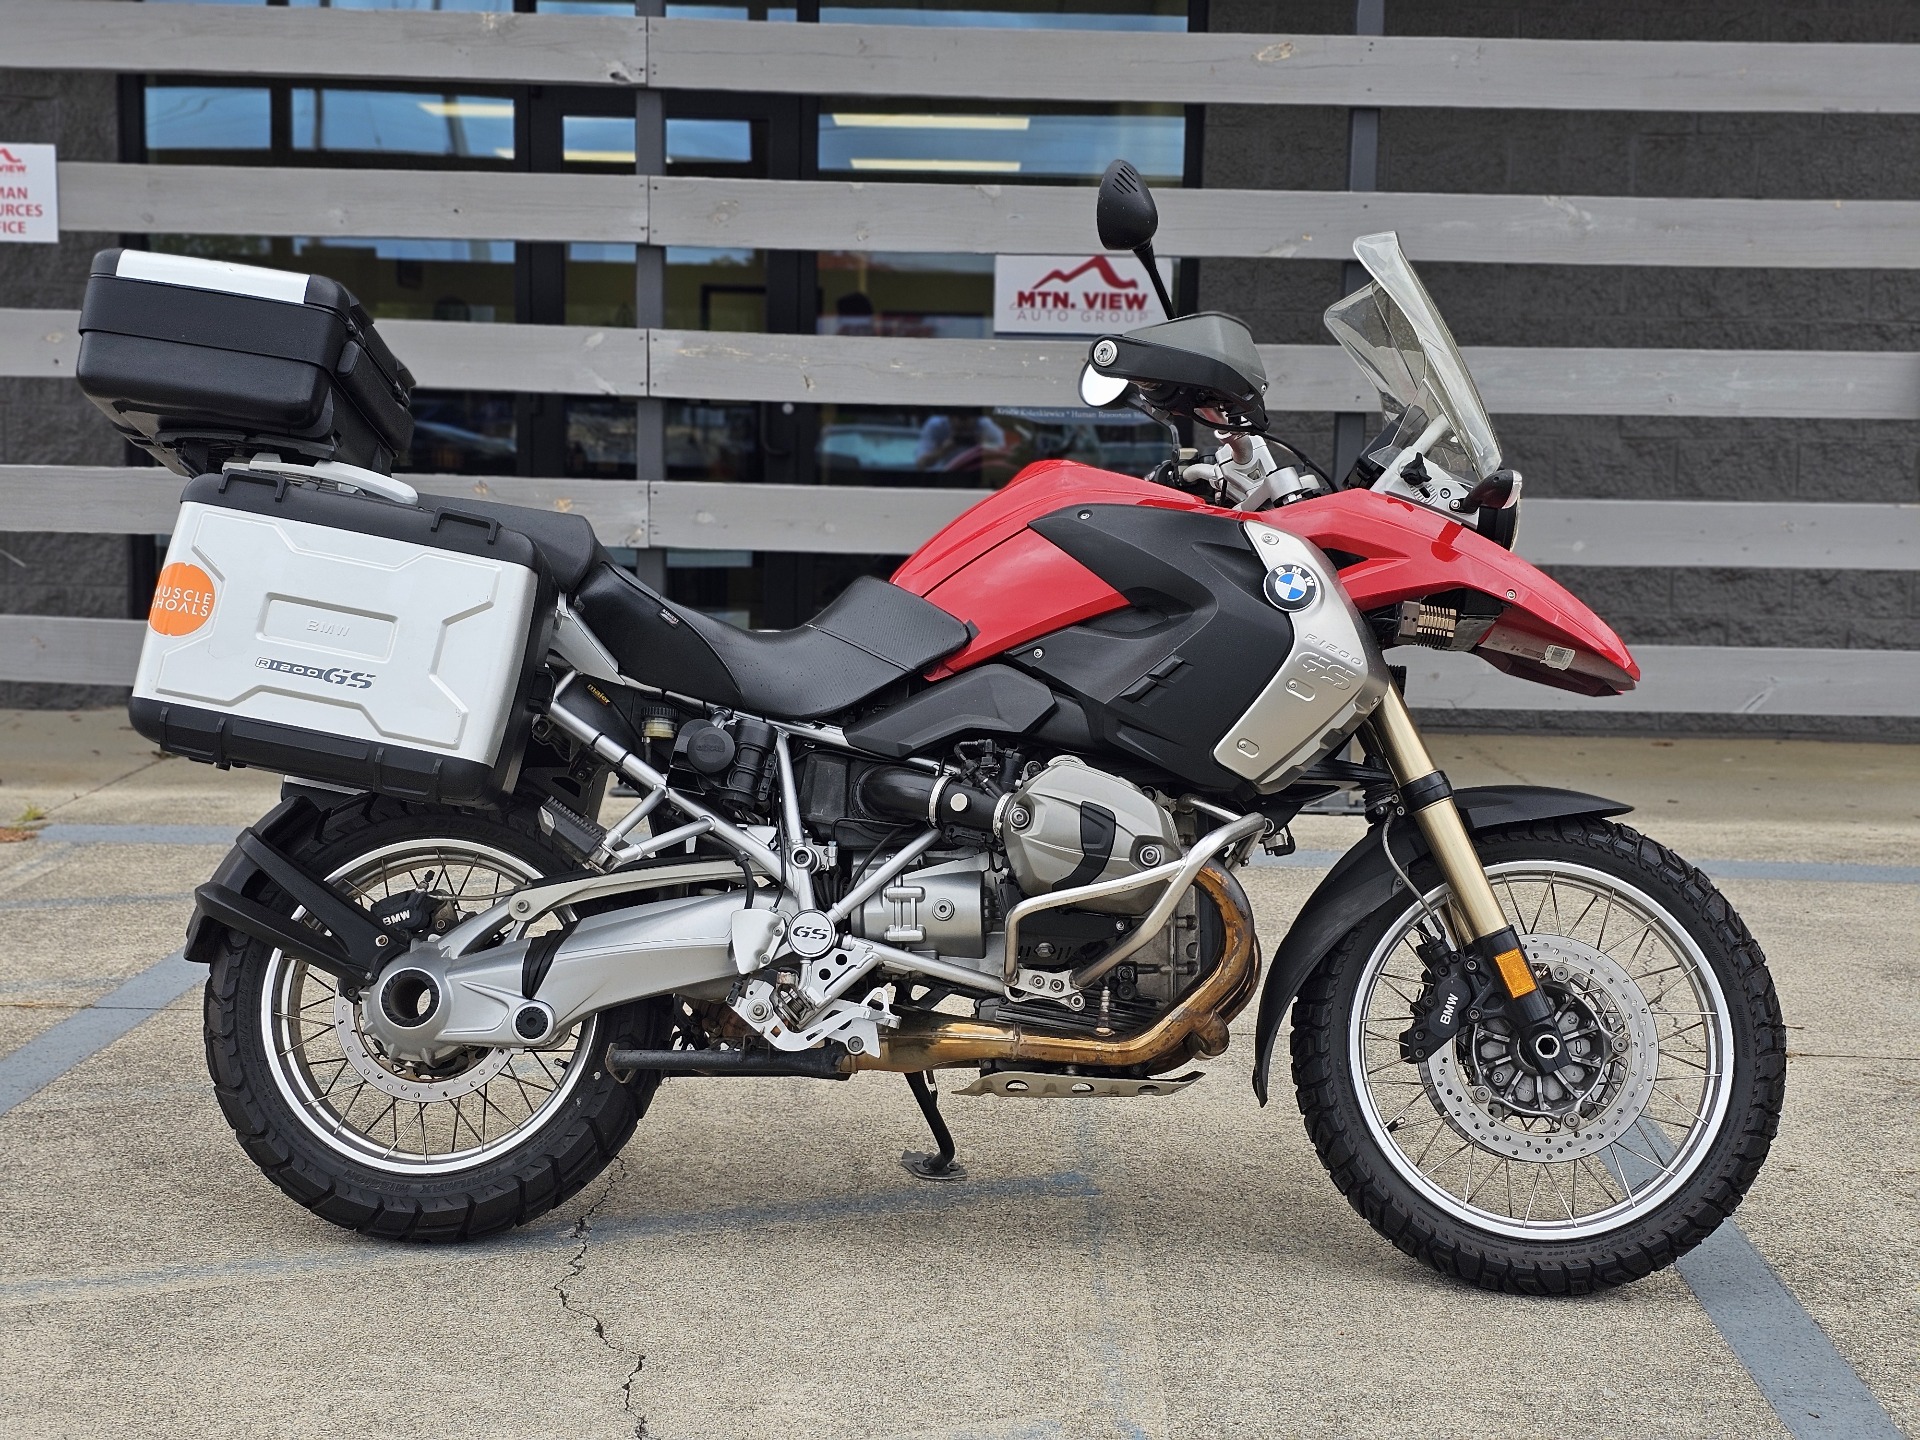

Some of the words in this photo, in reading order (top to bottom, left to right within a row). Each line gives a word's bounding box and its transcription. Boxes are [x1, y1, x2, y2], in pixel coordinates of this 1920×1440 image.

[1017, 291, 1076, 309] MTN.
[1083, 292, 1148, 311] VIEW
[1016, 310, 1069, 322] AUTO
[1081, 311, 1149, 323] GROUP
[1275, 565, 1315, 587] BMW
[152, 597, 209, 617] HOALS
[306, 619, 351, 637] BMW
[382, 909, 410, 926] BMW
[792, 925, 830, 940] GS
[1440, 992, 1459, 1025] BMW
